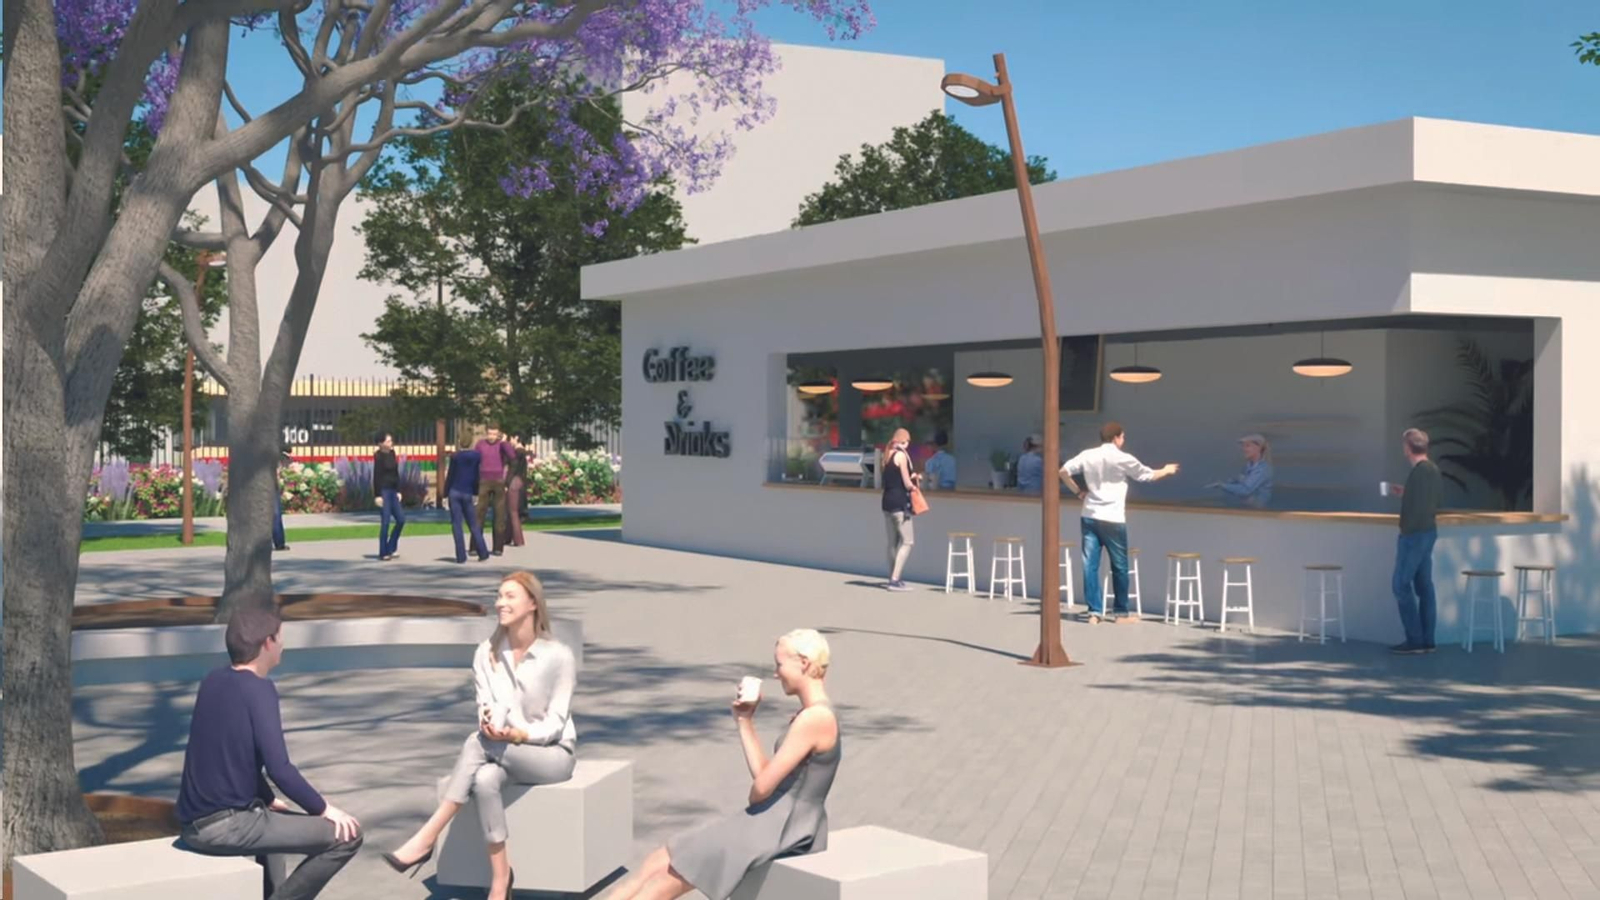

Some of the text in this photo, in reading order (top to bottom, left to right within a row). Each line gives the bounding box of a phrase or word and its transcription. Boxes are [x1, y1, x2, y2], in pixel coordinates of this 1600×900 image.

[642, 346, 716, 383] Coffee
[676, 390, 693, 419] &
[664, 421, 731, 458] Drinks
